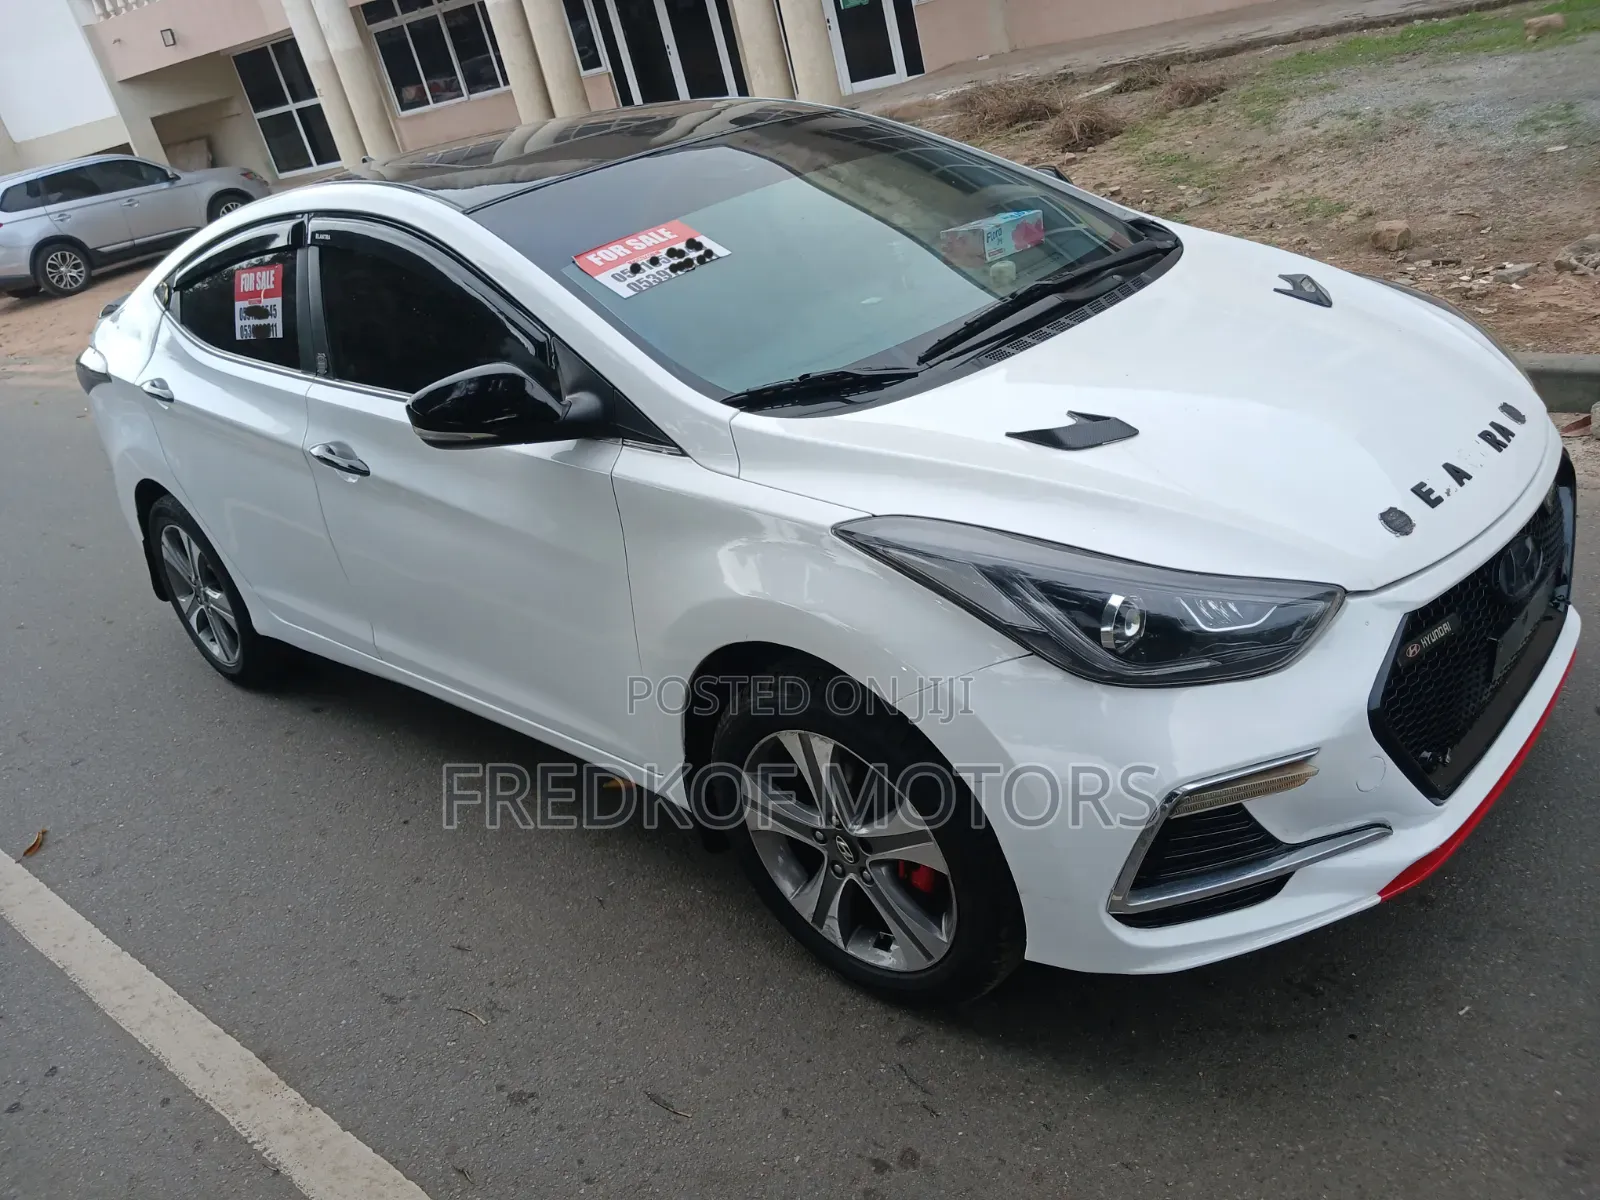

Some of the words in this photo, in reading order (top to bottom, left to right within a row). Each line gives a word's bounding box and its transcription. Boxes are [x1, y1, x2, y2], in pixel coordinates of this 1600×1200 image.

[585, 243, 632, 267] FOR
[626, 227, 679, 251] SALE
[240, 272, 255, 293] FOR
[256, 270, 275, 290] SALE
[1420, 621, 1452, 649] HYUNDAI
